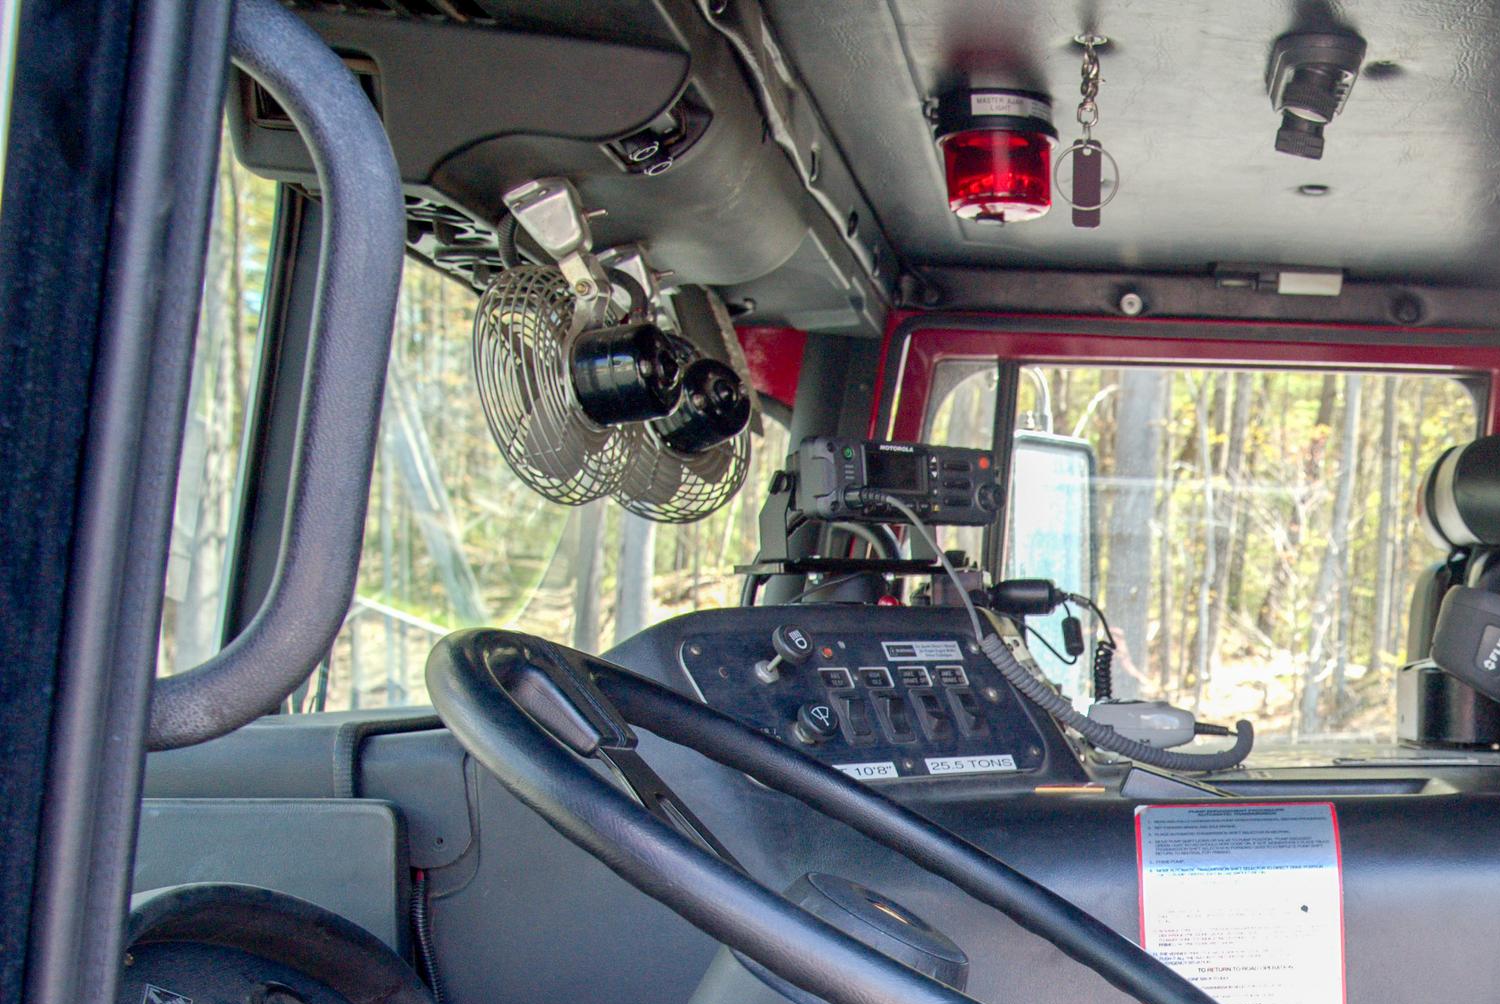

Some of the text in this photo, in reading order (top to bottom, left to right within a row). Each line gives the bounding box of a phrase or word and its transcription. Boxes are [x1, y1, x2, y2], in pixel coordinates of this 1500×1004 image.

[879, 444, 914, 453] MOTOROLA
[855, 765, 893, 777] 10'8"
[930, 759, 1013, 771] 25.5 TONS
